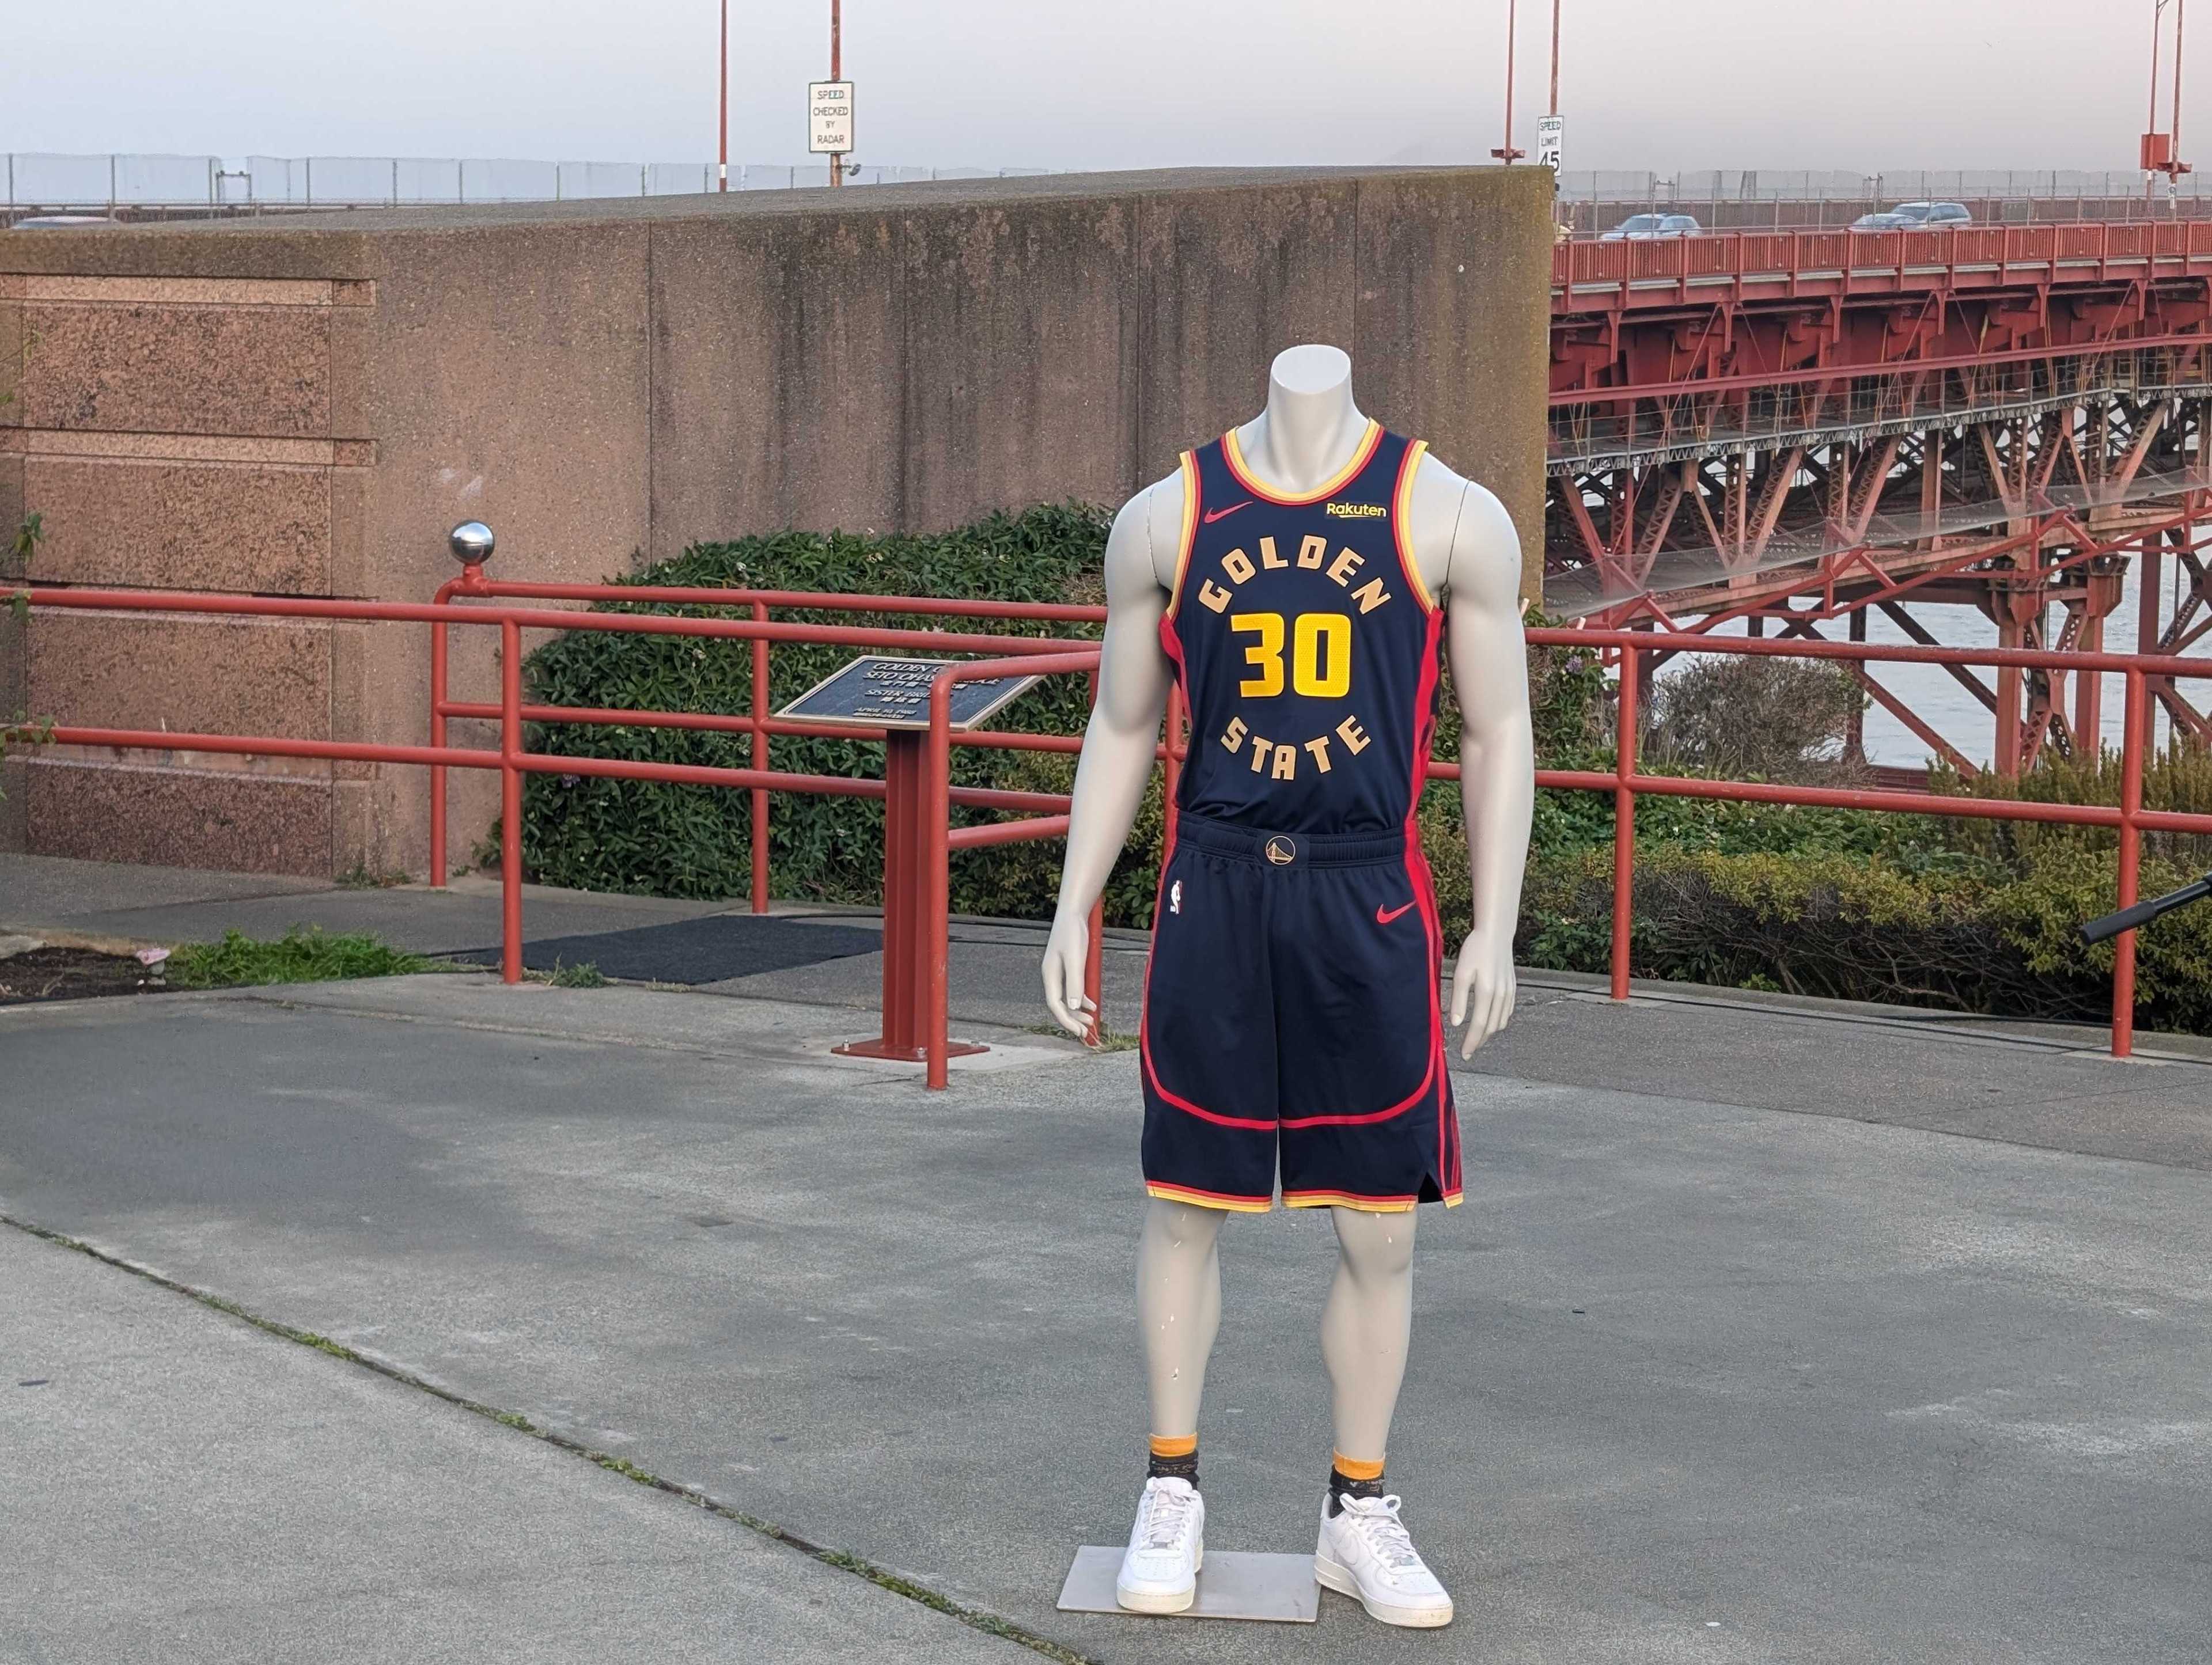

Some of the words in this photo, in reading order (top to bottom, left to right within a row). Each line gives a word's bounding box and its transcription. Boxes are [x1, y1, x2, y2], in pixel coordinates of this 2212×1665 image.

[817, 90, 844, 100] SPEED
[813, 106, 849, 116] CHECKED
[825, 120, 835, 128] BY
[1539, 121, 1561, 131] SPEED
[817, 134, 844, 144] RADAR
[1541, 136, 1558, 146] LIMIT
[1539, 150, 1560, 172] 45
[1327, 502, 1387, 517] Rakuten
[1198, 534, 1392, 615] GOLDEN
[1230, 613, 1351, 697] 30
[873, 662, 932, 673] GOLDEN
[863, 671, 898, 680] SETO
[1219, 715, 1372, 780] STATE
